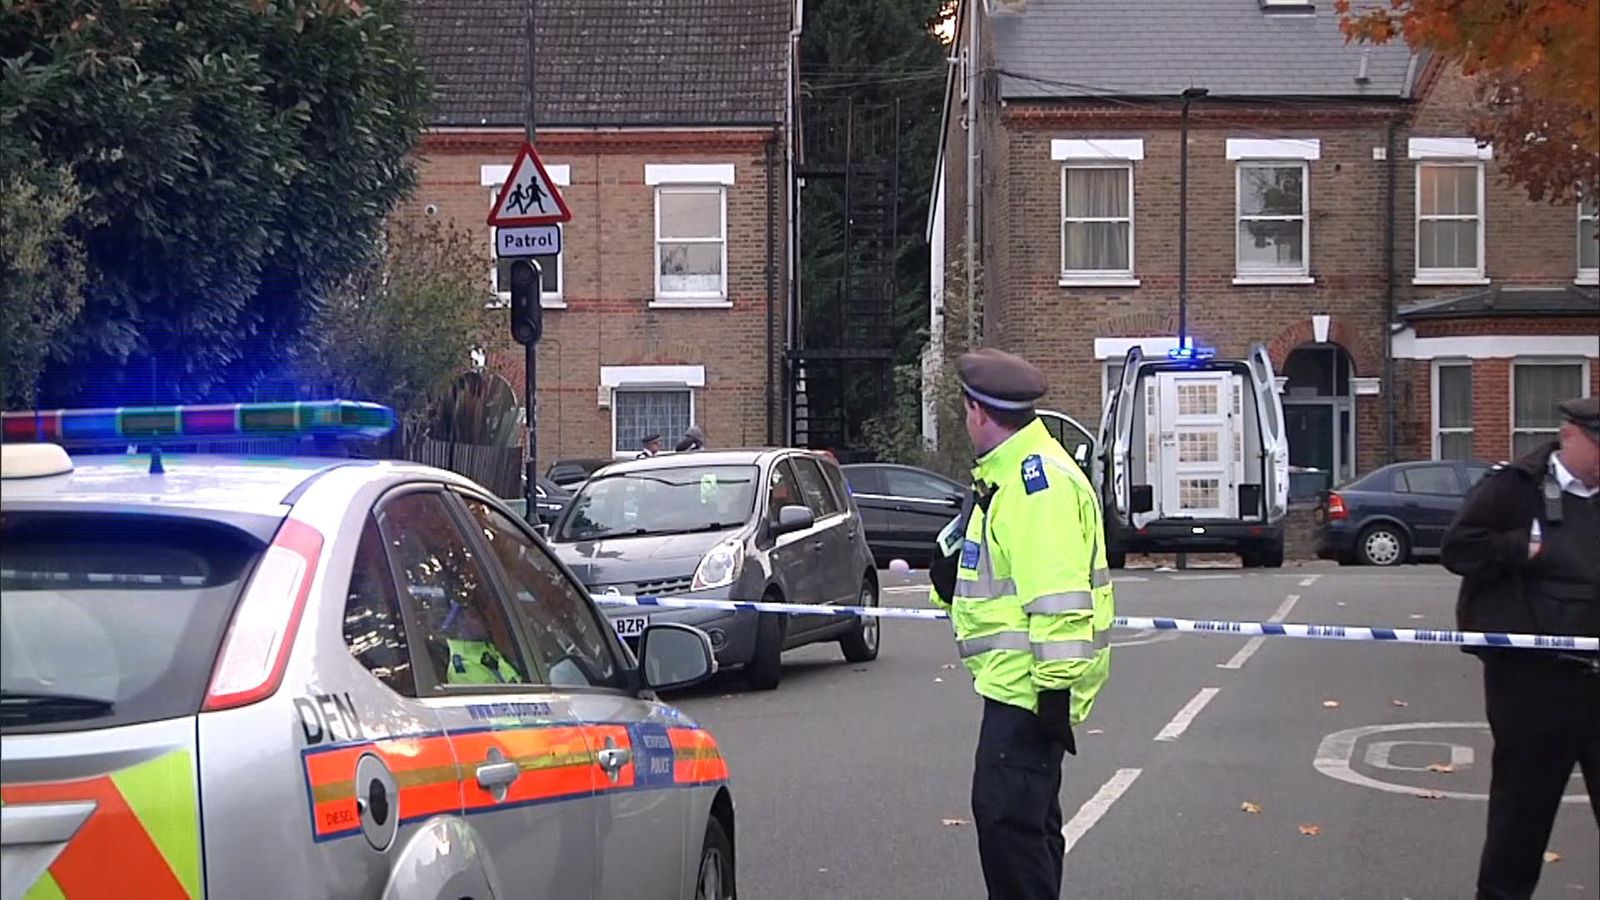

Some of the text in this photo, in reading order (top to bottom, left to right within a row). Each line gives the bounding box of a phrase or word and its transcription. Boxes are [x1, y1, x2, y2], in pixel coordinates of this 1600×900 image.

[504, 232, 553, 248] Patrol
[293, 692, 364, 745] DFN
[326, 809, 354, 826] DIESEL
